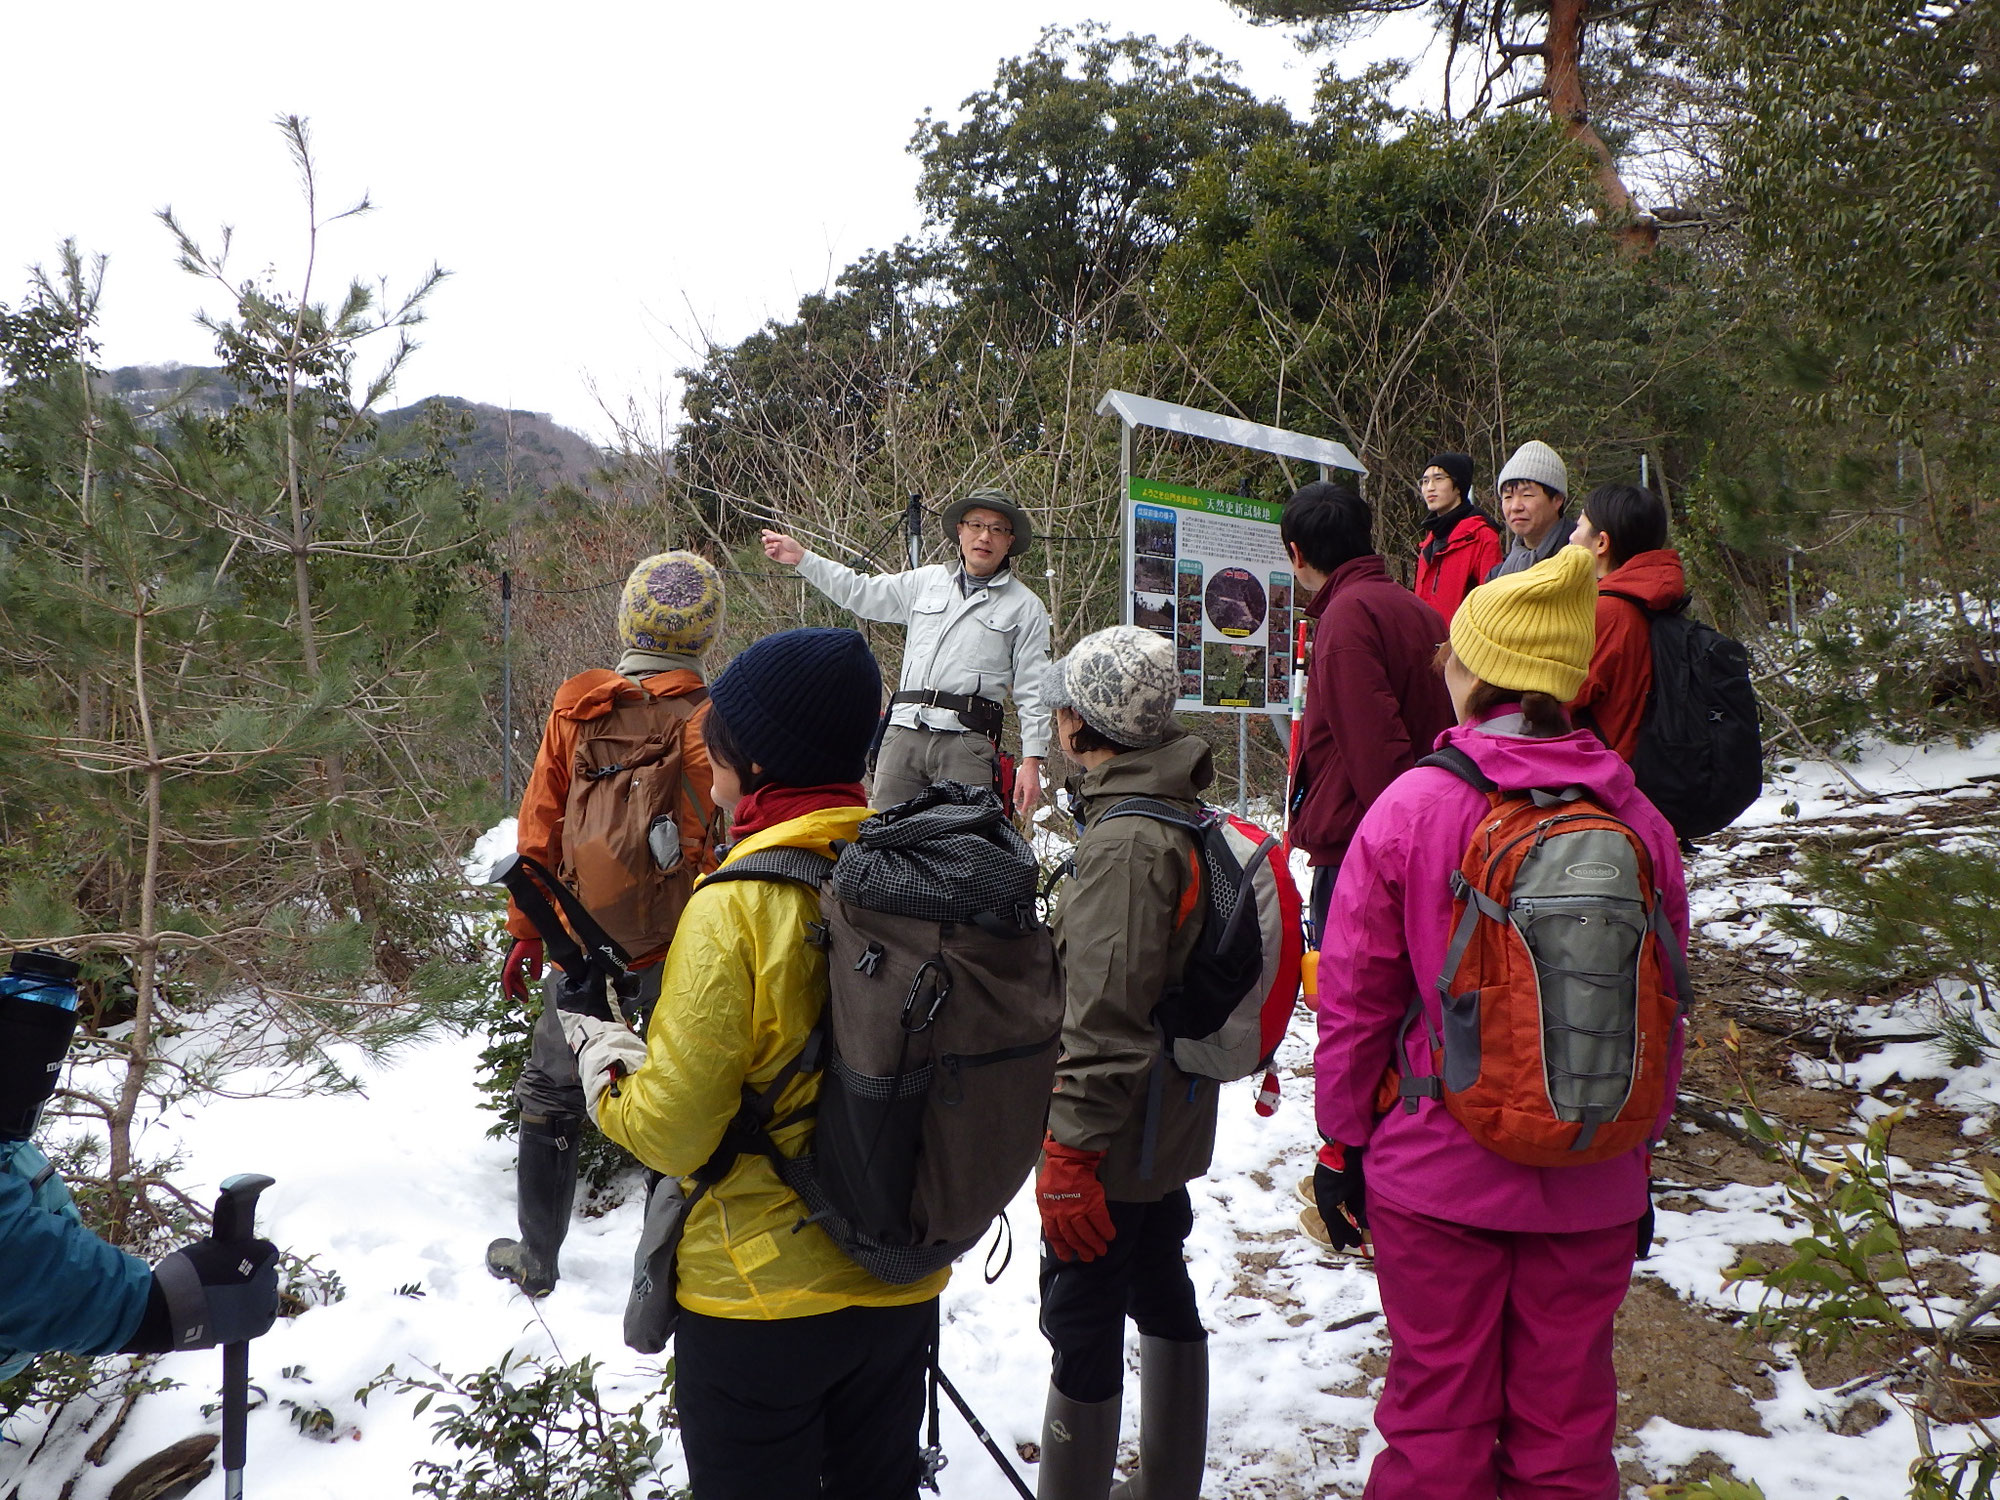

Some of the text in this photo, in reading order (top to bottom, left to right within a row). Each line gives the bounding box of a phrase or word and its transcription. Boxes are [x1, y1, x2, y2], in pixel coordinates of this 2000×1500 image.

[1206, 497, 1271, 521] 天然更新試験地
